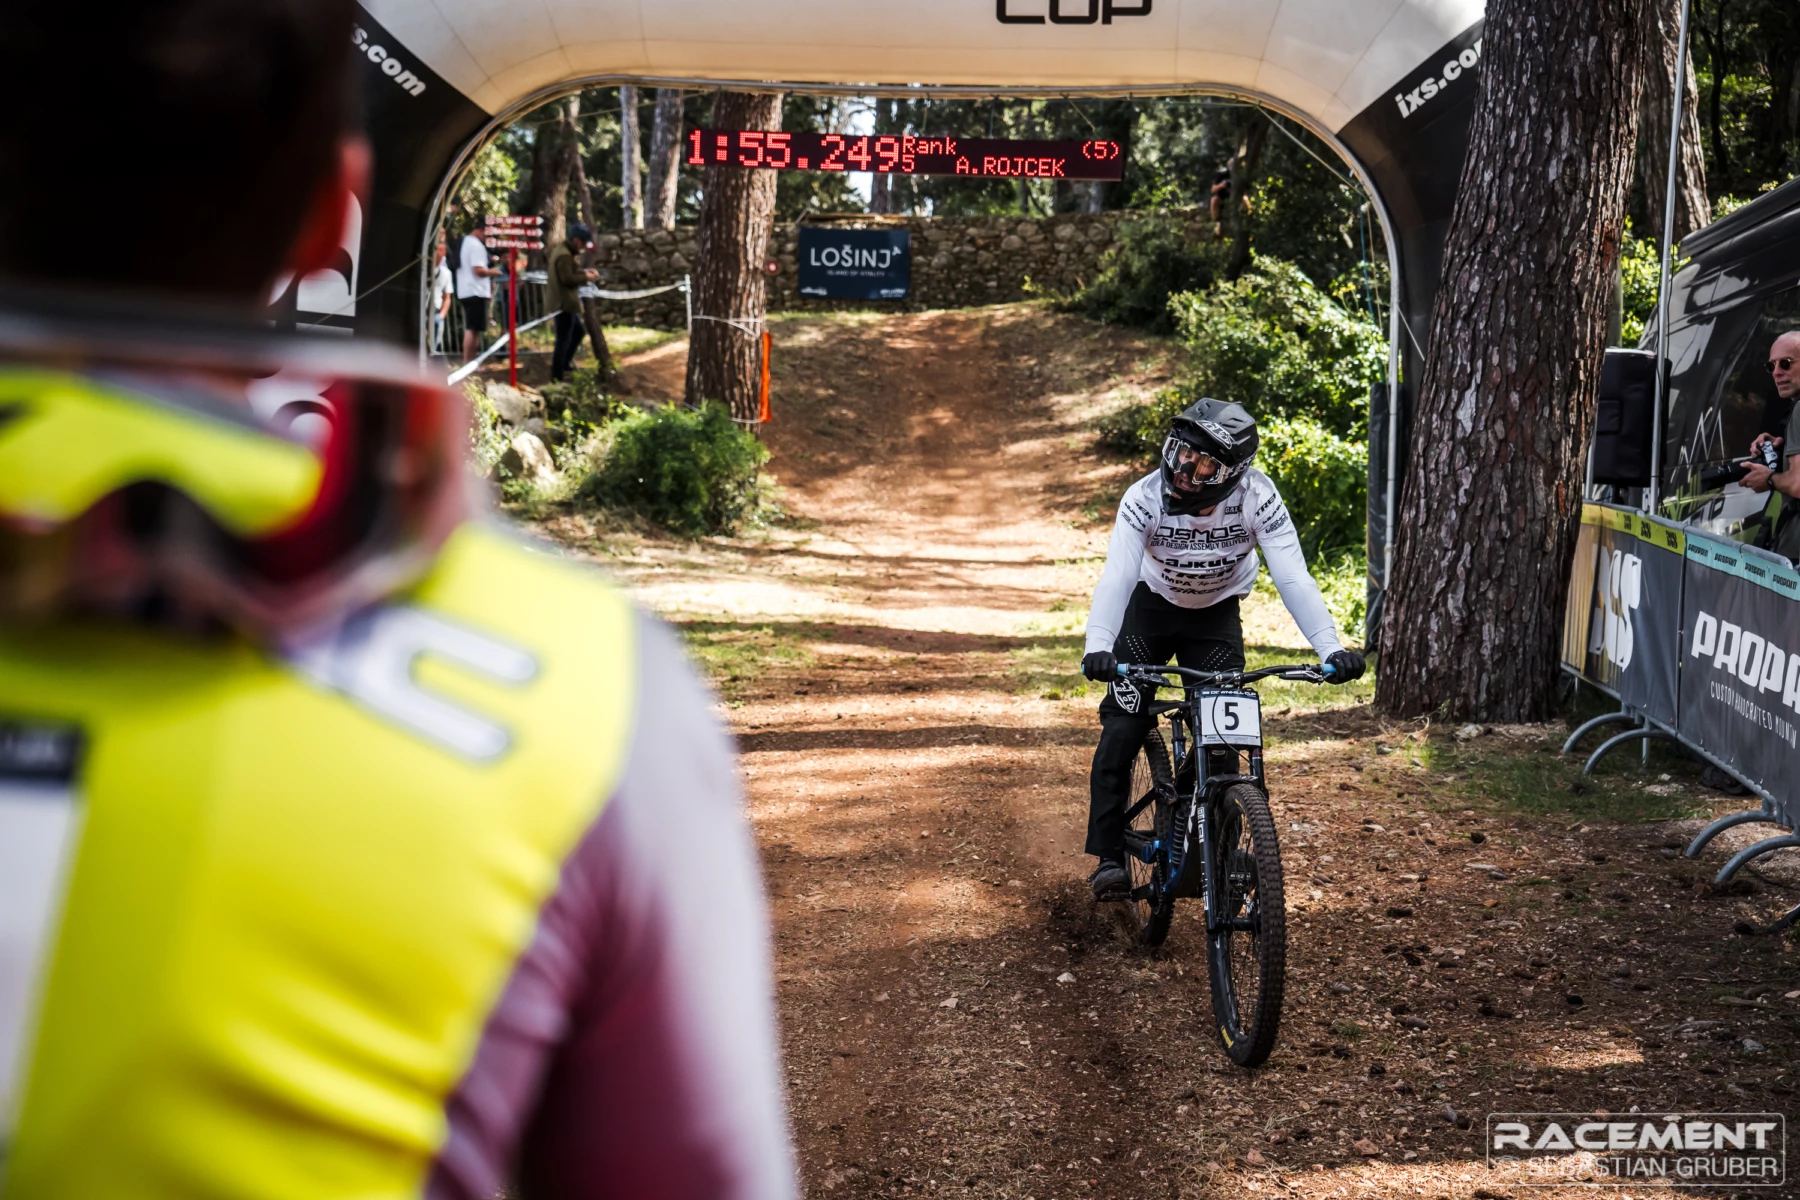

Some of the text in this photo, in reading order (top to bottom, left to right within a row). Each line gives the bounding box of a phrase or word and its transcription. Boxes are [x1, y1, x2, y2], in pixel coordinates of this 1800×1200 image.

[351, 26, 426, 97] s.com
[689, 129, 900, 172] 1:55.249
[902, 136, 956, 155] Rank
[1082, 140, 1119, 160] (5)
[901, 154, 915, 172] 5
[956, 156, 1065, 177] A.ROJCEK
[810, 244, 891, 268] LOŠINJ
[1166, 541, 1189, 550] DESIGN
[1221, 537, 1250, 549] DELIVERY
[1224, 702, 1240, 731] 5
